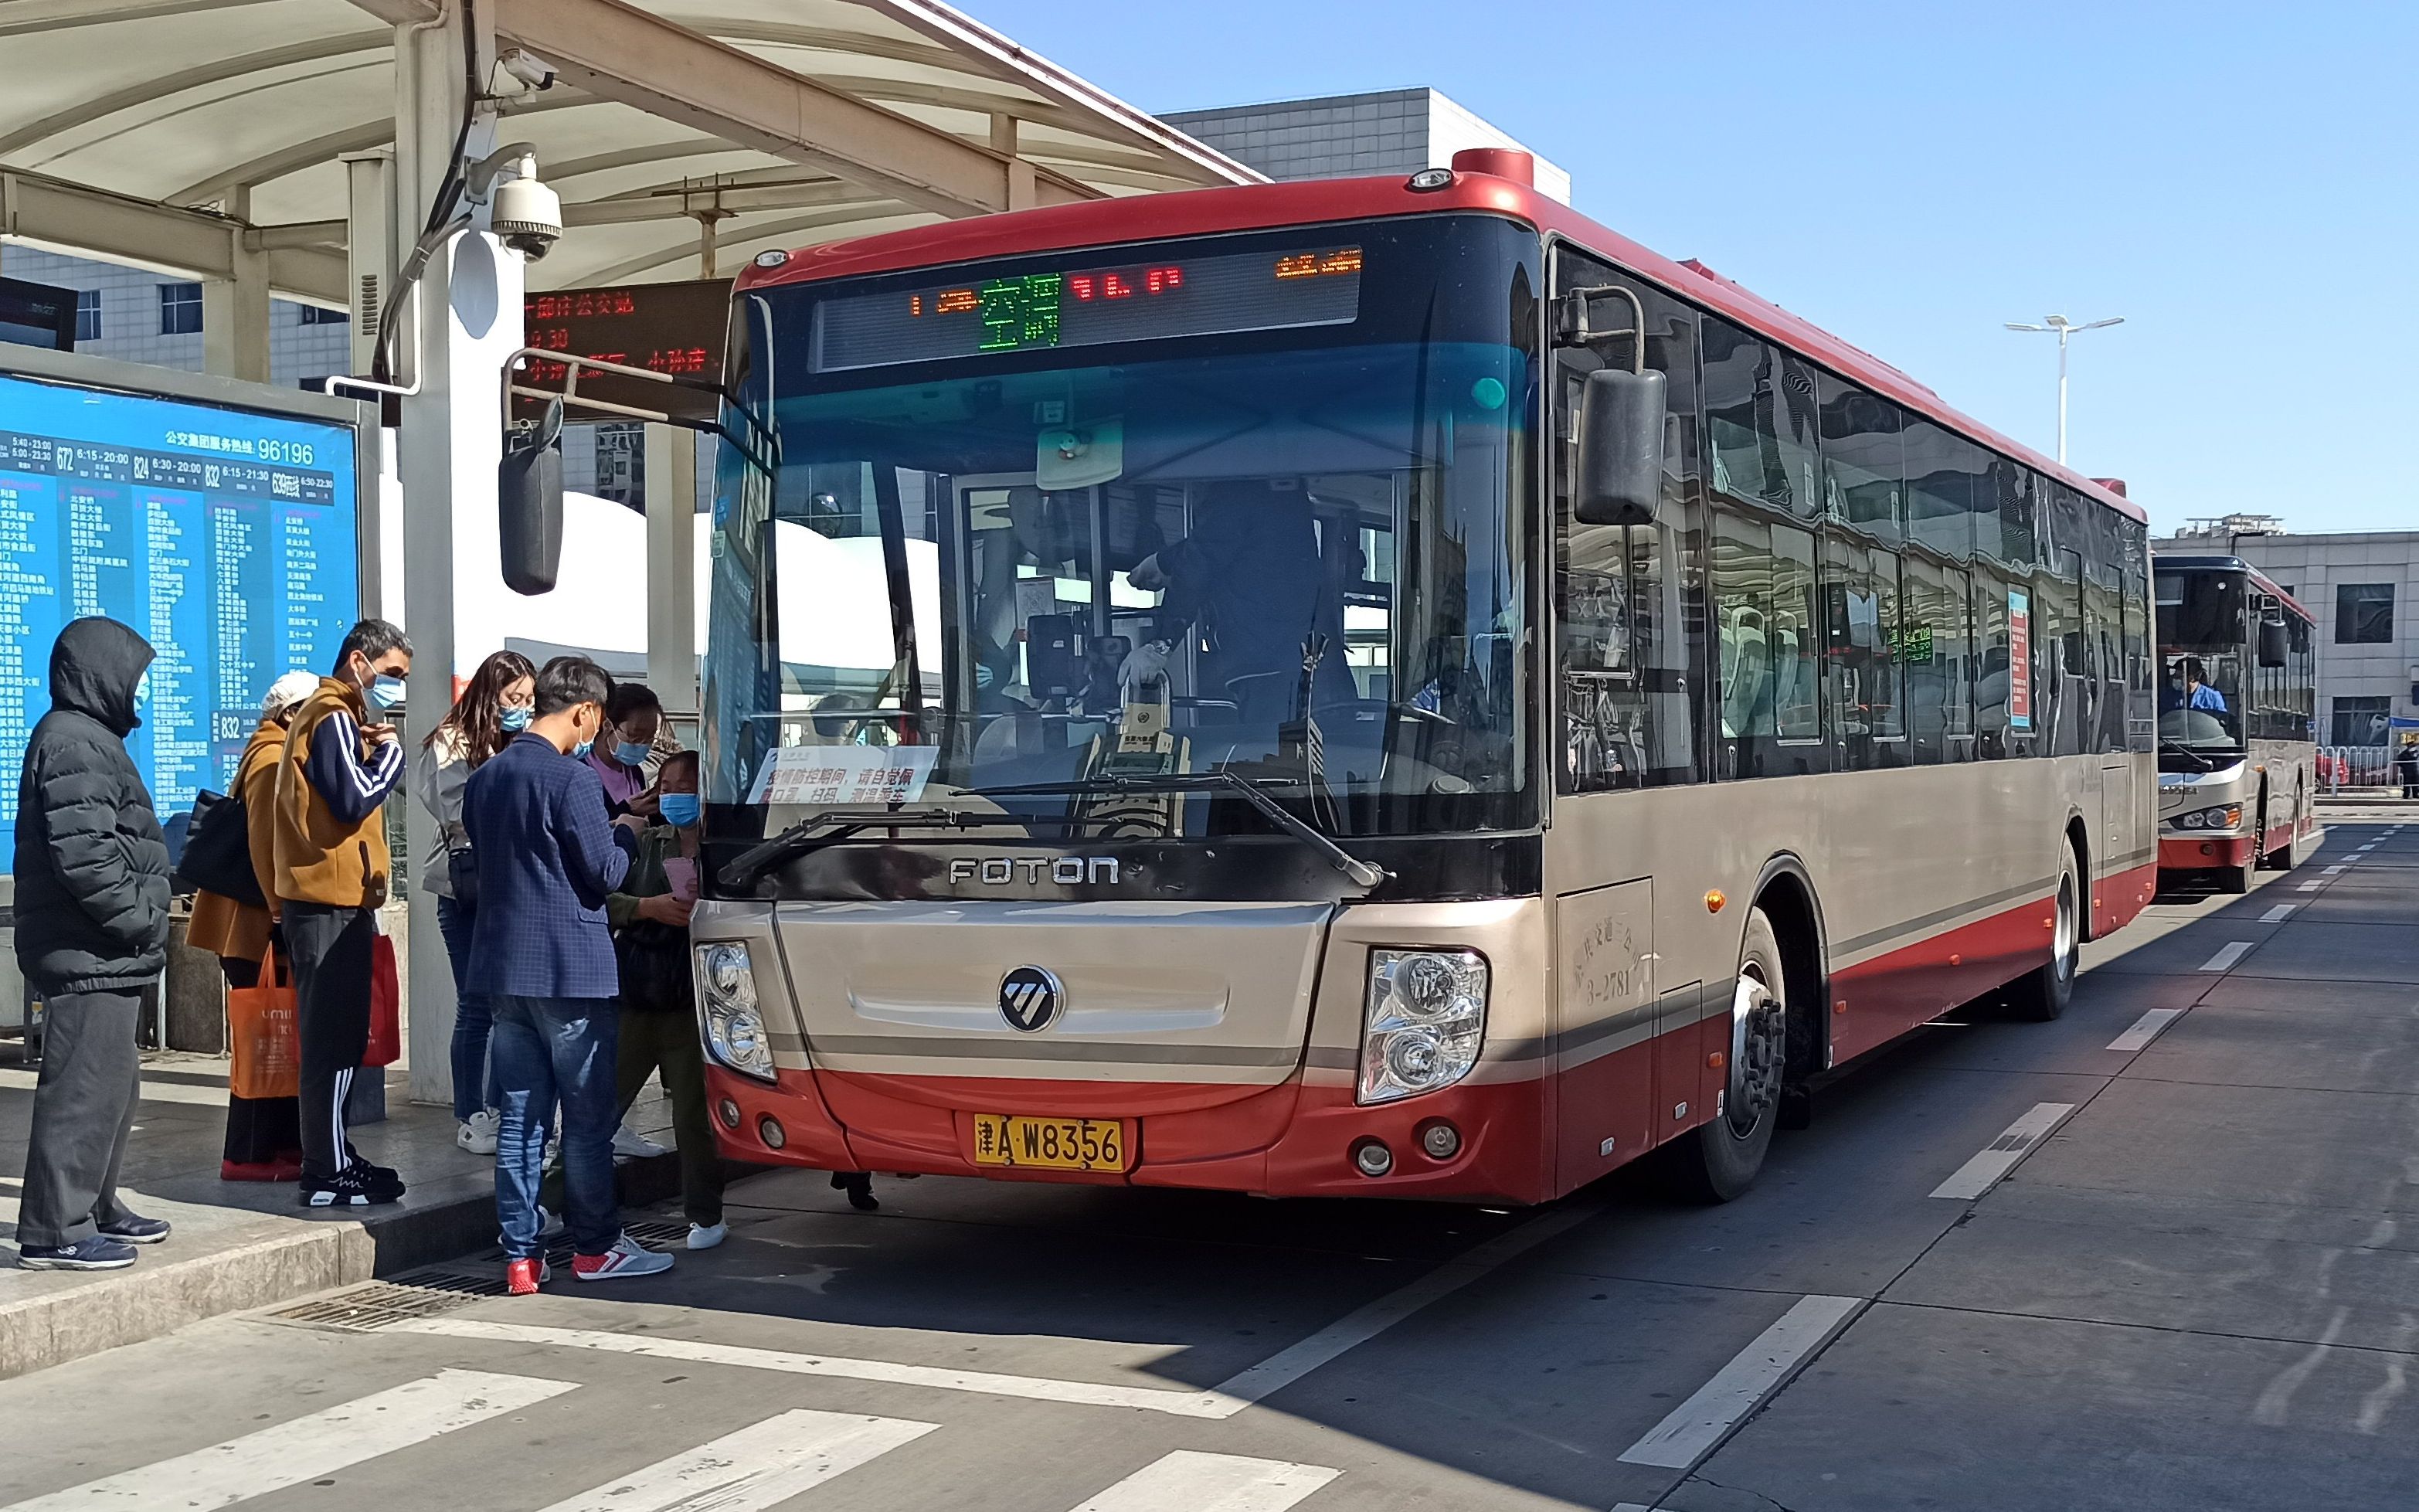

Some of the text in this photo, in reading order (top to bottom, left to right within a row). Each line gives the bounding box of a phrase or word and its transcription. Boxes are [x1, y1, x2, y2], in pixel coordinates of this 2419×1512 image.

[56, 446, 74, 471] 672
[258, 438, 314, 465] 96196
[134, 456, 149, 479] 824
[206, 464, 220, 488] 832
[222, 717, 240, 739] 832
[950, 856, 1119, 885] FOTON
